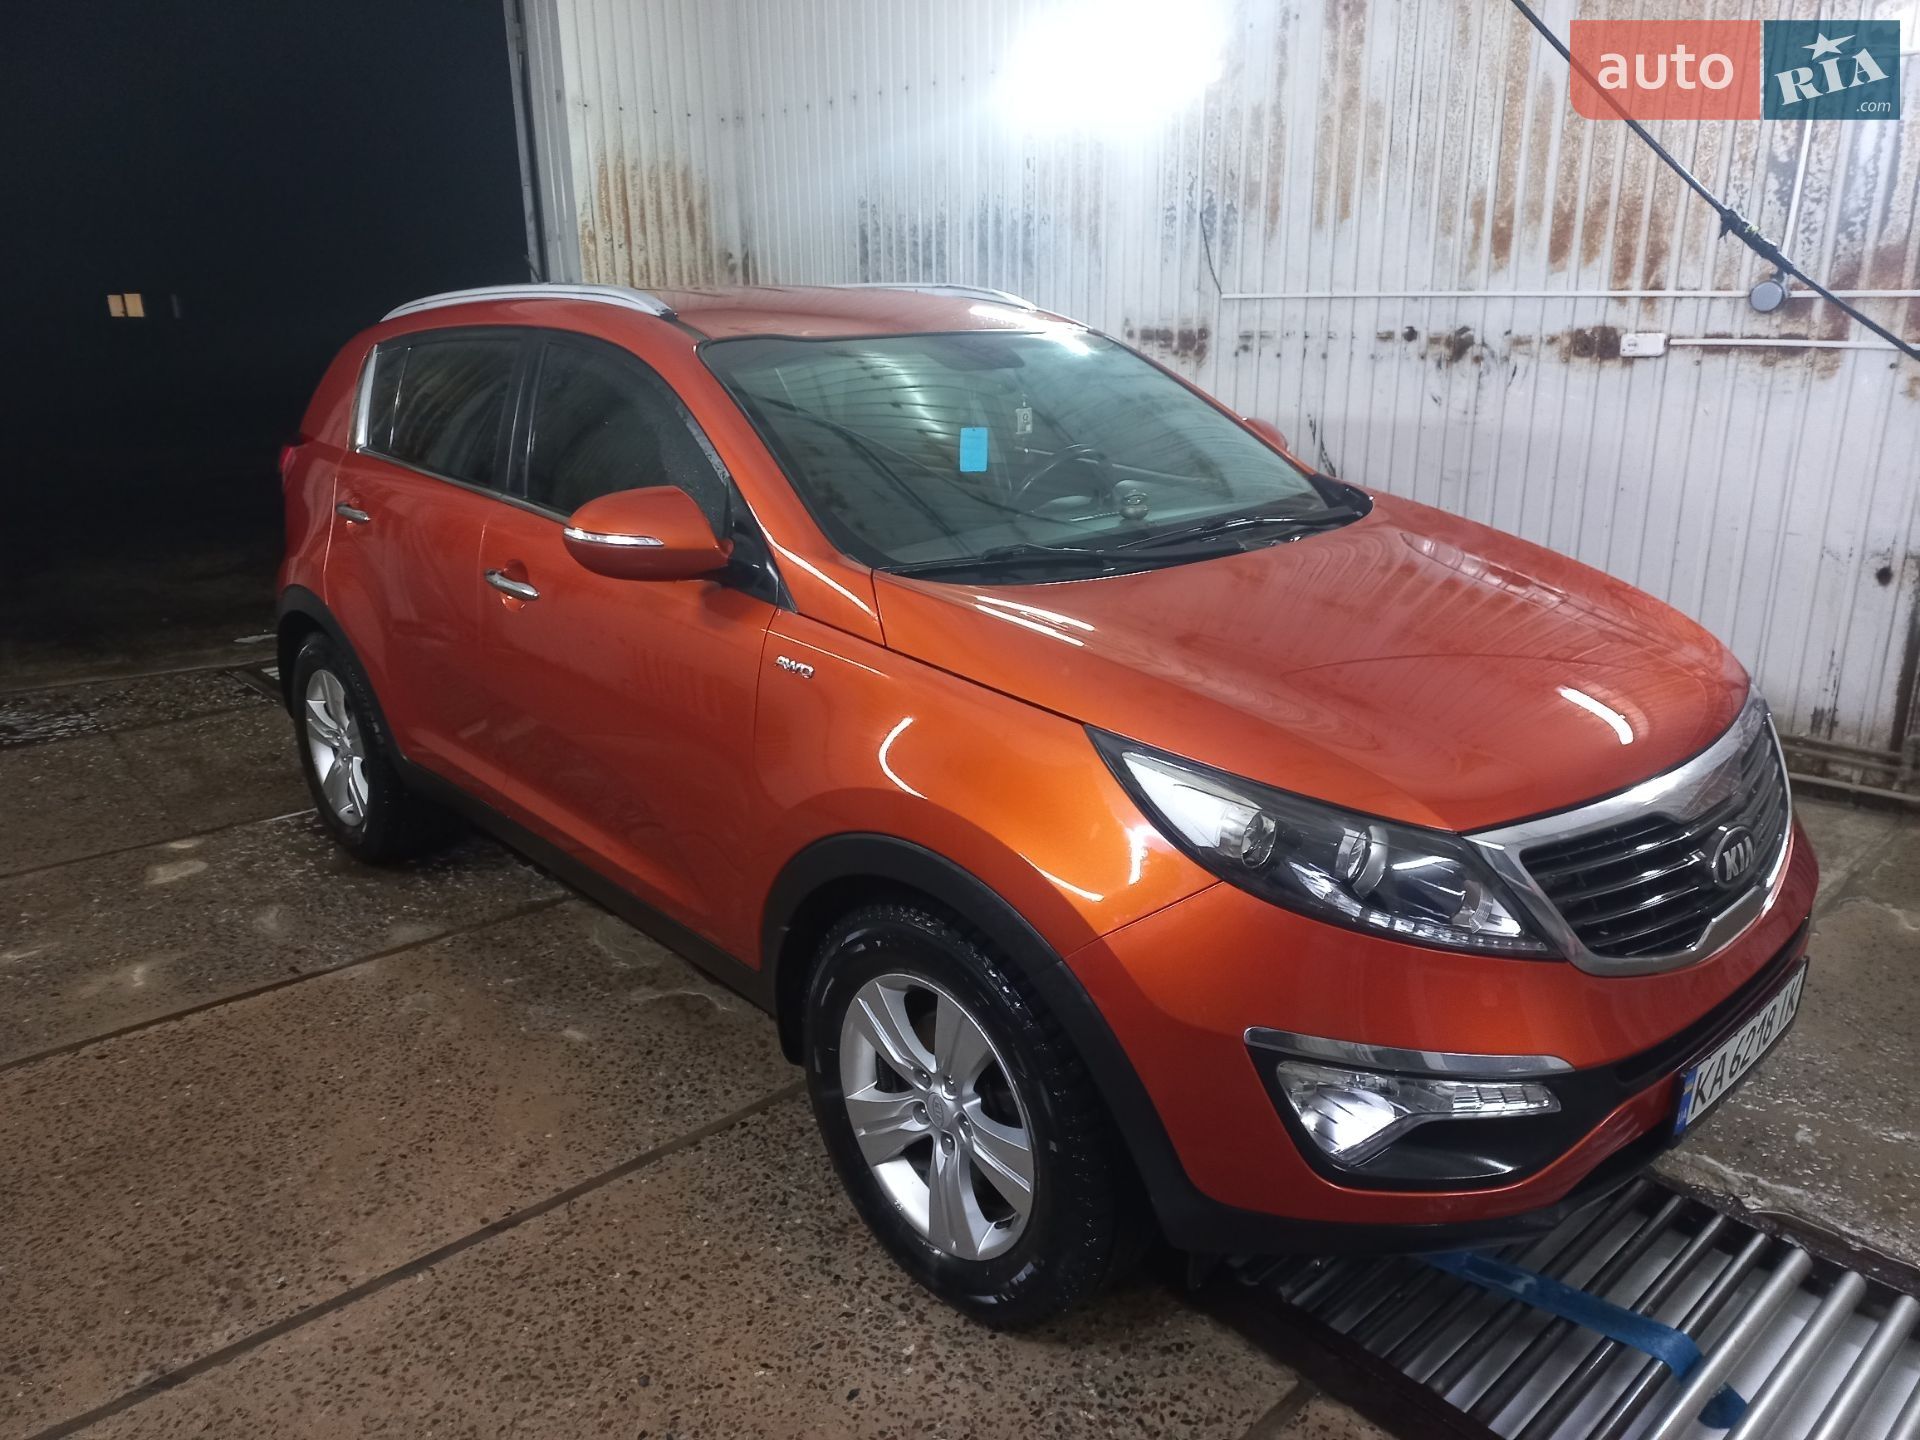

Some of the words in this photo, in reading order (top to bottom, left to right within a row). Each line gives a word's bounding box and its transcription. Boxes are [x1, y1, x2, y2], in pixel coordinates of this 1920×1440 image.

[1722, 836, 1754, 881] KIA
[1691, 1051, 1727, 1115] KA
[1728, 1003, 1777, 1079] 6218
[1777, 973, 1802, 1030] IK
